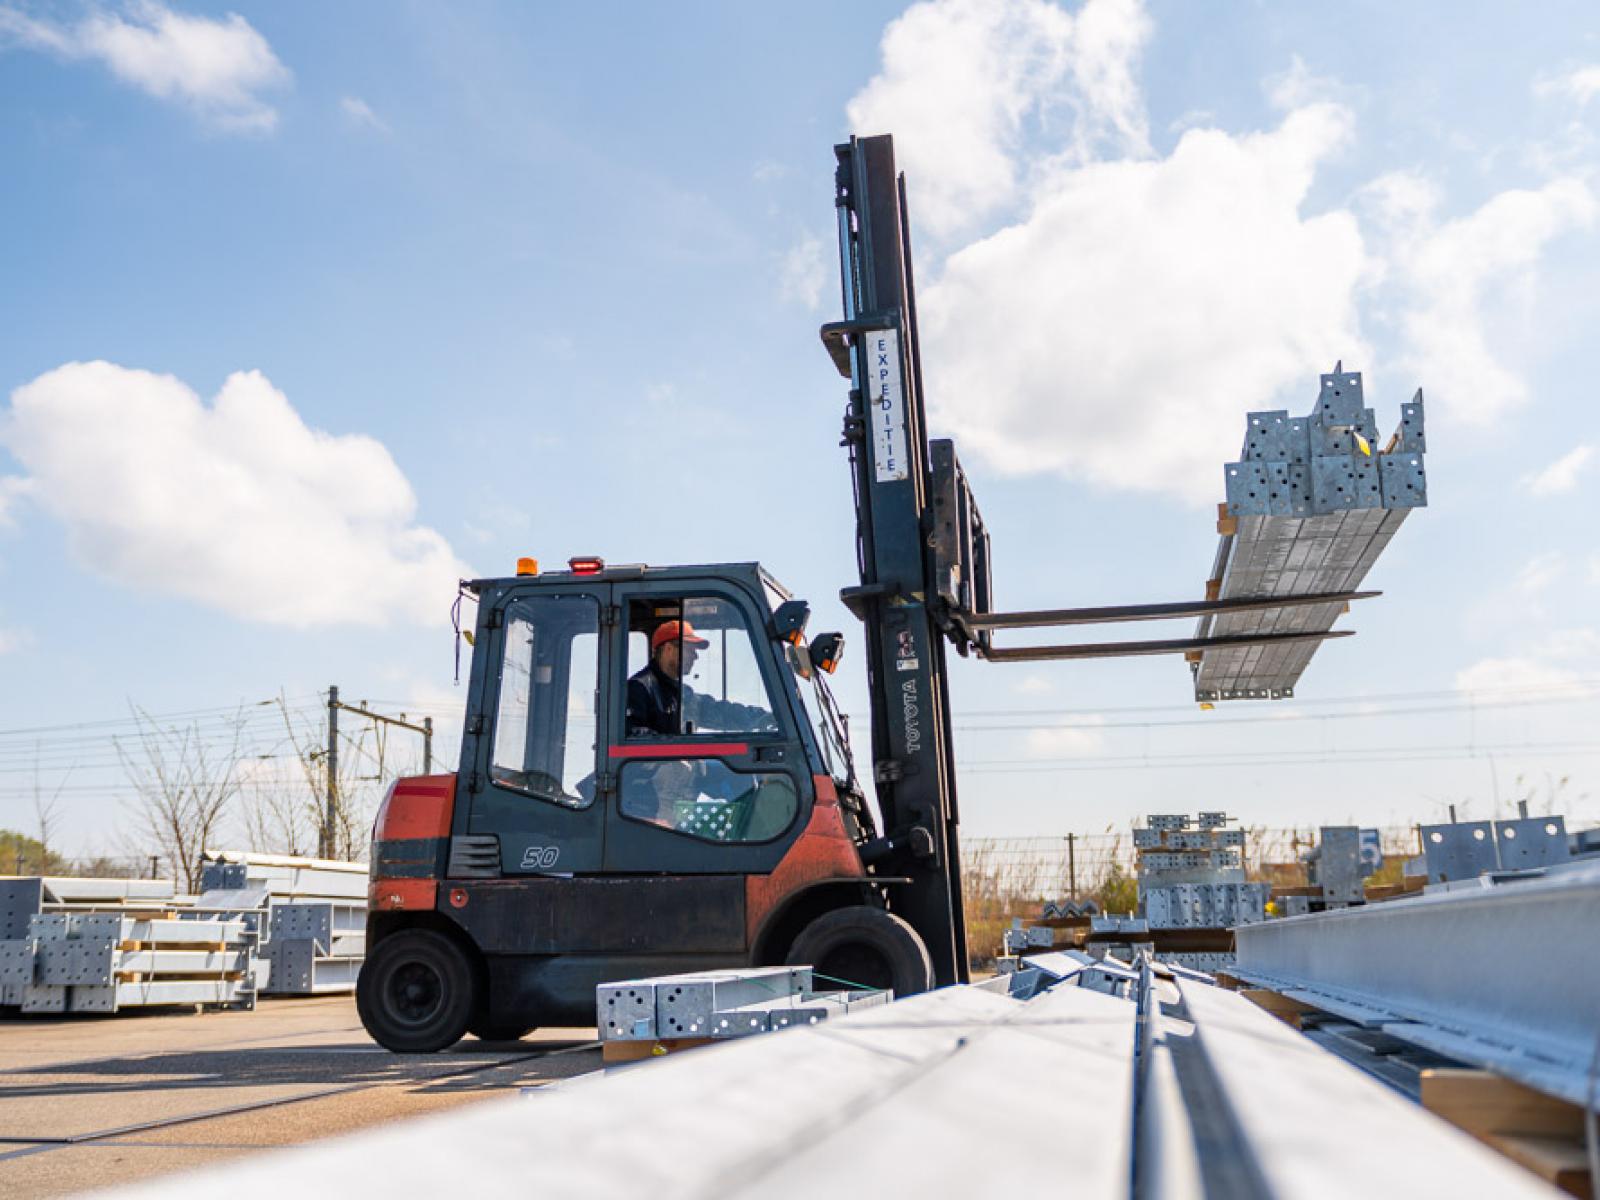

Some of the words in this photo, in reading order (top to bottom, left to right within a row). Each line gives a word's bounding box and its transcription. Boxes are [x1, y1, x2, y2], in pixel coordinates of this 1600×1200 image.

[878, 339, 896, 472] EXPEDITIE
[902, 678, 921, 754] TOYOTA
[520, 847, 560, 868] 50
